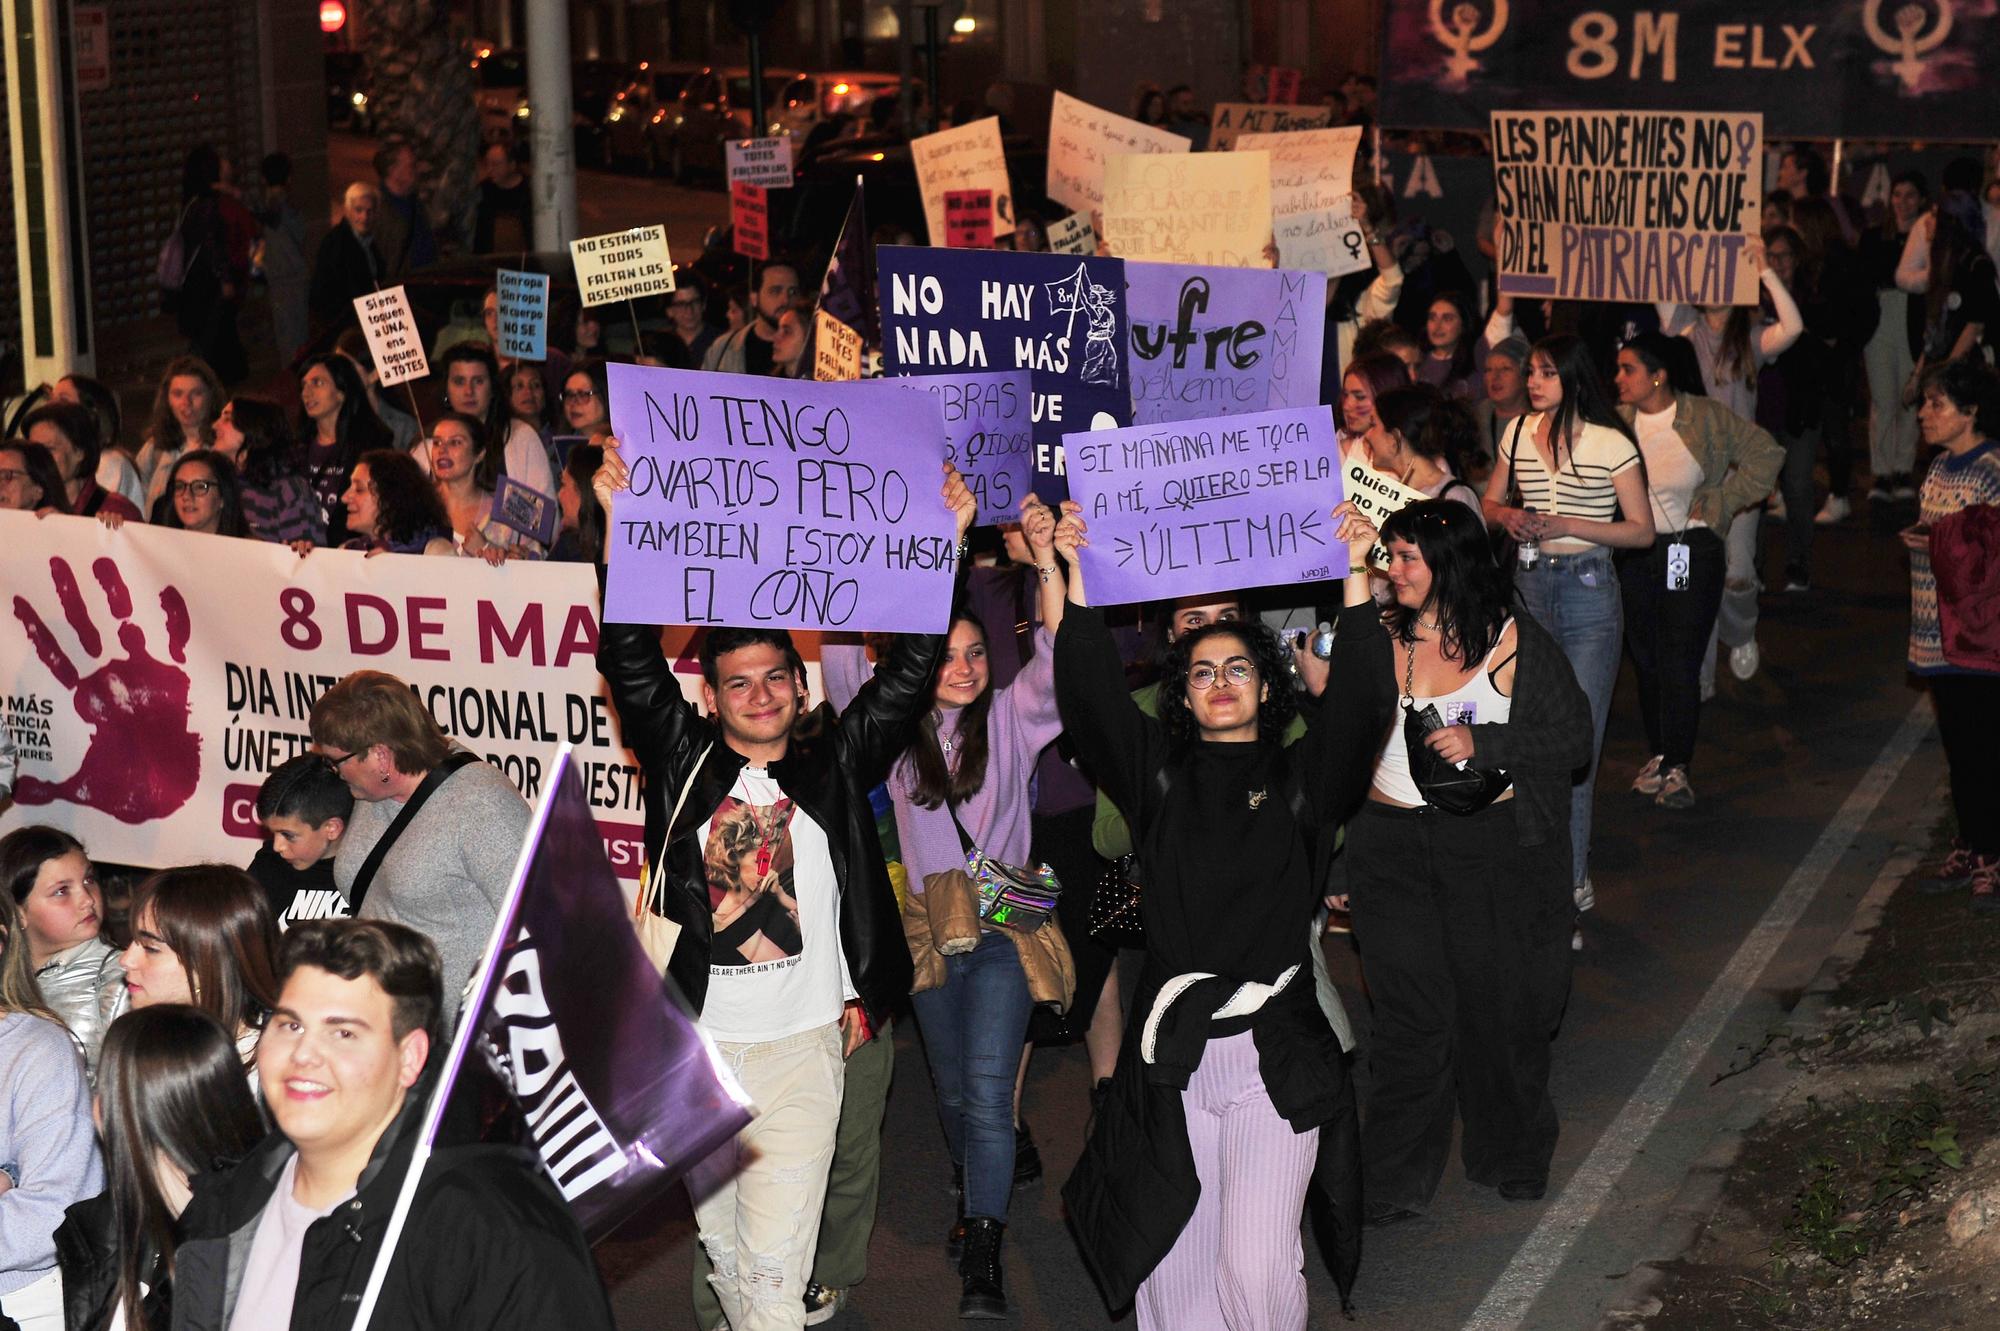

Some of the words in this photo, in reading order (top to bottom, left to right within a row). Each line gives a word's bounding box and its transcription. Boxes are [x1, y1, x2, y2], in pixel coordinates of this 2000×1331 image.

[1566, 11, 1679, 82] 8M
[1713, 24, 1817, 70] ELX
[1494, 118, 1539, 164] LES
[1692, 119, 1732, 170] NO
[1497, 166, 1559, 223] S'HAN
[1565, 168, 1642, 227] ACABAT
[1645, 170, 1689, 230] ENS
[577, 241, 596, 254] NO
[600, 229, 660, 250] ESTAMOS
[600, 248, 643, 265] TODAS
[587, 268, 636, 287] FALTAN
[640, 263, 663, 277] LAS
[1501, 222, 1524, 274] DA
[1527, 223, 1549, 275] EL
[1559, 225, 1746, 304] PATRIARCAT
[365, 298, 378, 311] Si
[379, 294, 397, 307] ens
[587, 278, 670, 303] ASESINADAS
[892, 272, 944, 317] NO
[981, 280, 1034, 321] HAY
[368, 307, 405, 325] toquen
[503, 322, 518, 334] NO
[521, 323, 536, 336] SE
[1132, 276, 1266, 370] ufre
[375, 328, 382, 338] a
[386, 336, 406, 349] ens
[505, 339, 533, 353] TOCA
[382, 348, 418, 366] toquen
[895, 326, 988, 367] NADA
[1015, 332, 1070, 374] MÁS
[384, 370, 391, 379] a
[391, 360, 425, 377] TOTES
[645, 391, 699, 443] NO
[710, 396, 850, 455] TENGO
[1031, 391, 1062, 423] UE
[1079, 443, 1114, 473] SI
[1121, 431, 1214, 471] MAÑANA
[1222, 430, 1250, 453] ME
[1257, 422, 1310, 454] TOCA
[629, 456, 780, 509] OVARIOS
[797, 458, 908, 524] PERO
[1094, 493, 1108, 519] A
[1163, 467, 1250, 512] QUIERO
[1257, 461, 1298, 488] SER
[1304, 456, 1329, 480] LA
[1350, 467, 1401, 502] Quien
[1351, 492, 1373, 509] no
[786, 526, 876, 567] ESTOY
[886, 533, 956, 574] HASTA
[1139, 512, 1297, 576] ÚLTIMA
[1301, 566, 1329, 579] NADIA
[684, 567, 724, 622] EL
[750, 567, 859, 625] COÑO
[279, 587, 322, 651] 8
[344, 593, 451, 662] DE
[8, 693, 53, 715] MÁS
[225, 662, 280, 717] DIA
[566, 693, 610, 747] DE
[7, 714, 51, 730] ENCIA
[721, 968, 733, 976] ARE
[735, 965, 755, 975] THERE
[776, 961, 785, 970] NO
